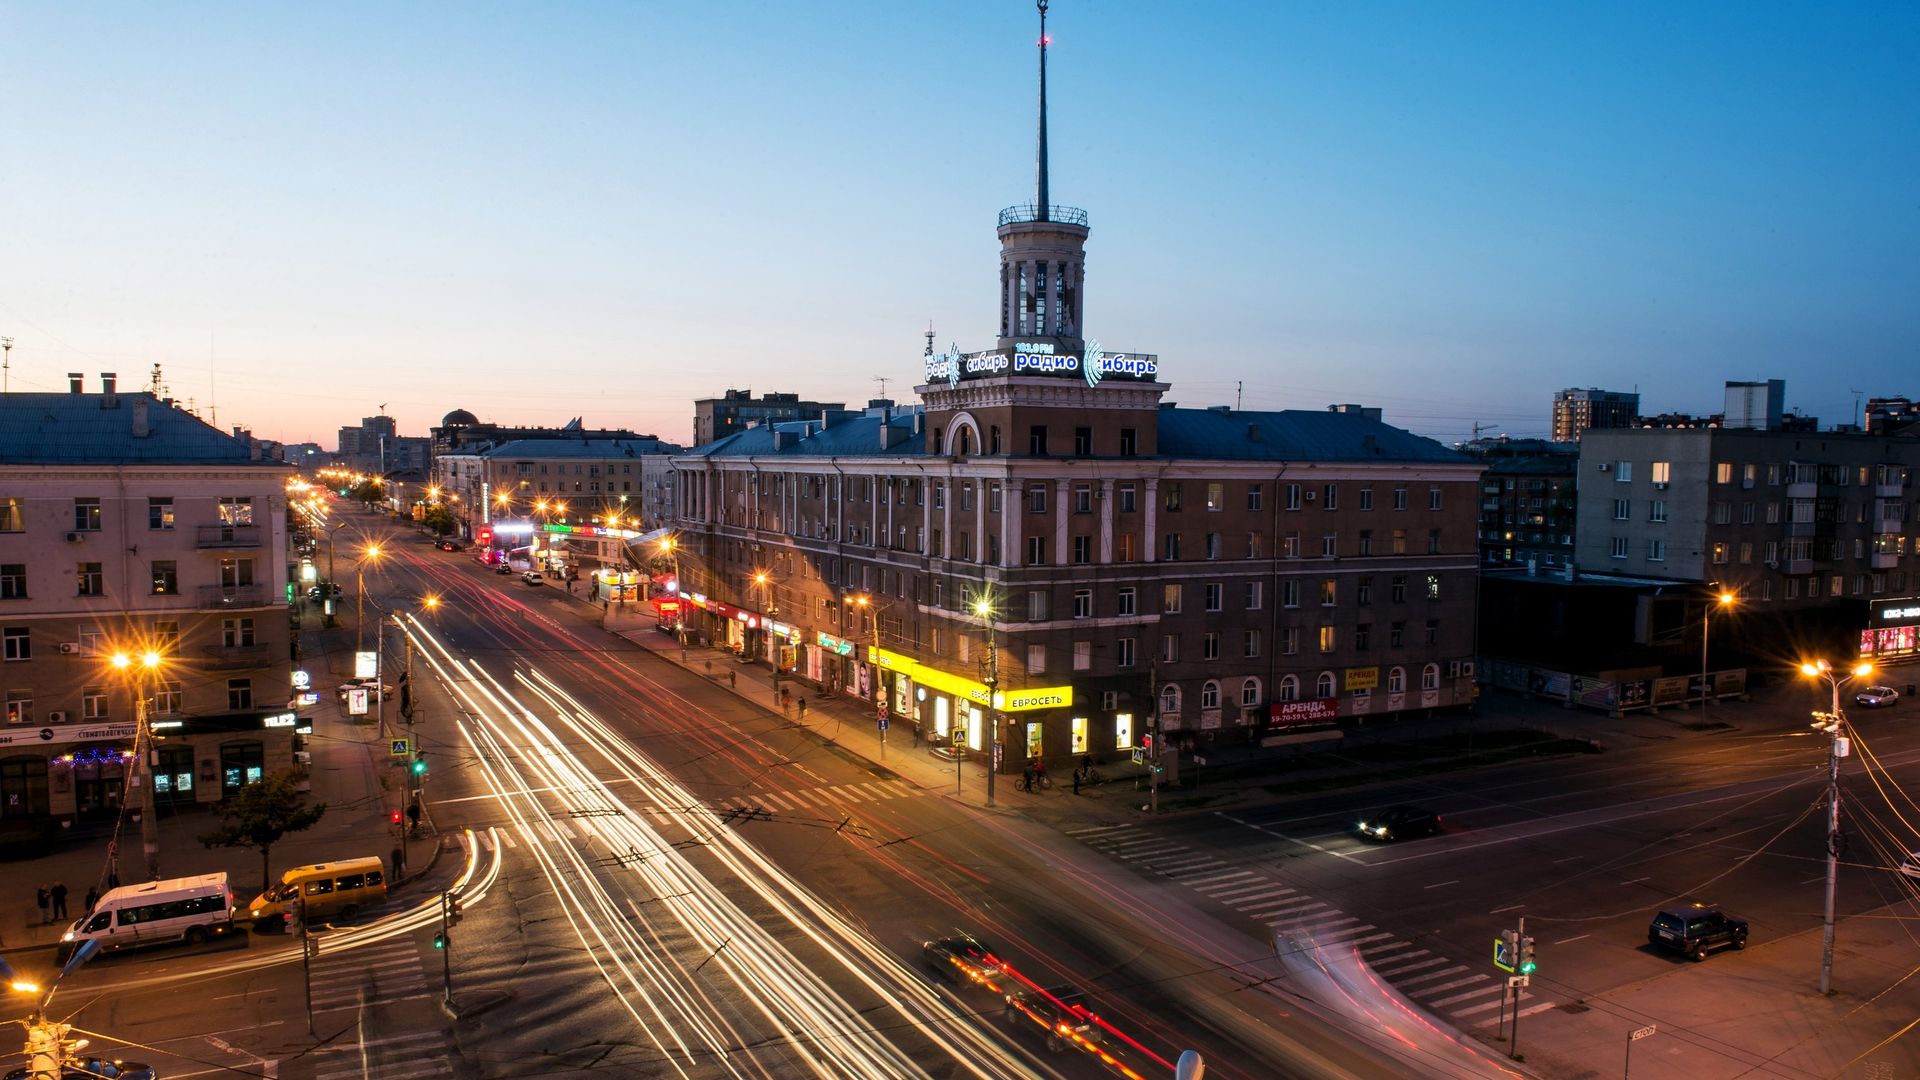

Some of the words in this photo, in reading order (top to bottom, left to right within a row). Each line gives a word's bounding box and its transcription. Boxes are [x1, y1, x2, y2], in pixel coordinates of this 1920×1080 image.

[1039, 344, 1054, 355] FM
[926, 362, 959, 381] рад
[966, 351, 1009, 373] сибирь
[1015, 353, 1078, 372] радио
[1012, 696, 1063, 708] ЕВРОСЕТЬ
[1281, 701, 1326, 714] АРЕНДА
